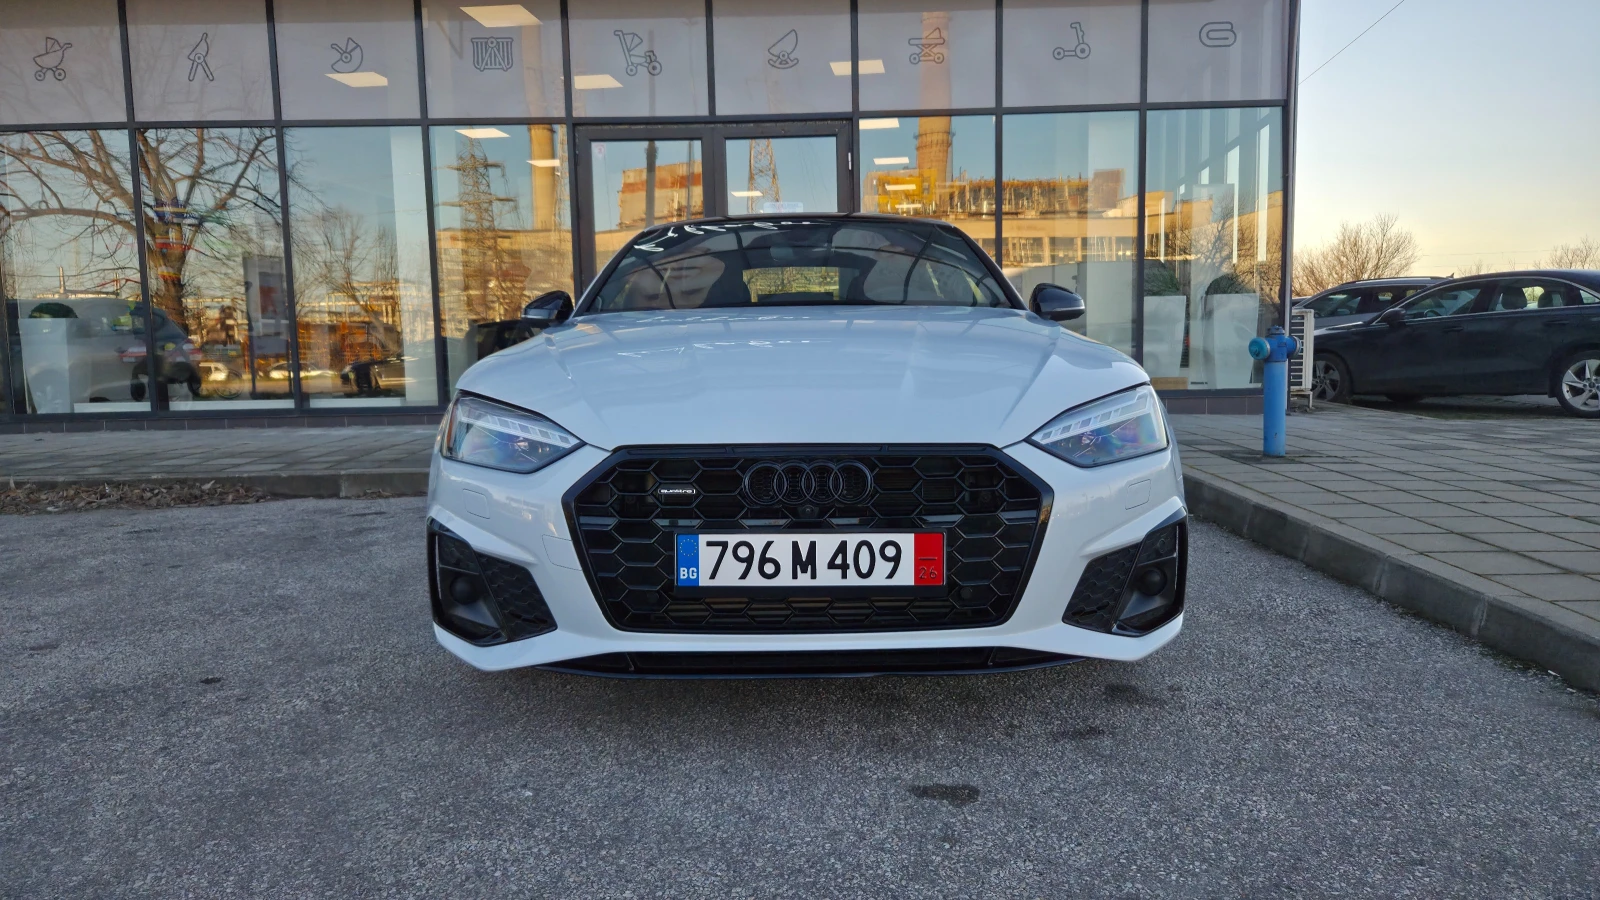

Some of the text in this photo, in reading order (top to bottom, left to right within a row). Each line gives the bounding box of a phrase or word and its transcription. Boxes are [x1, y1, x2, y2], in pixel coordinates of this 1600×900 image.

[706, 539, 902, 580] 796 M 409
[680, 567, 698, 579] BG
[919, 566, 938, 579] 26
